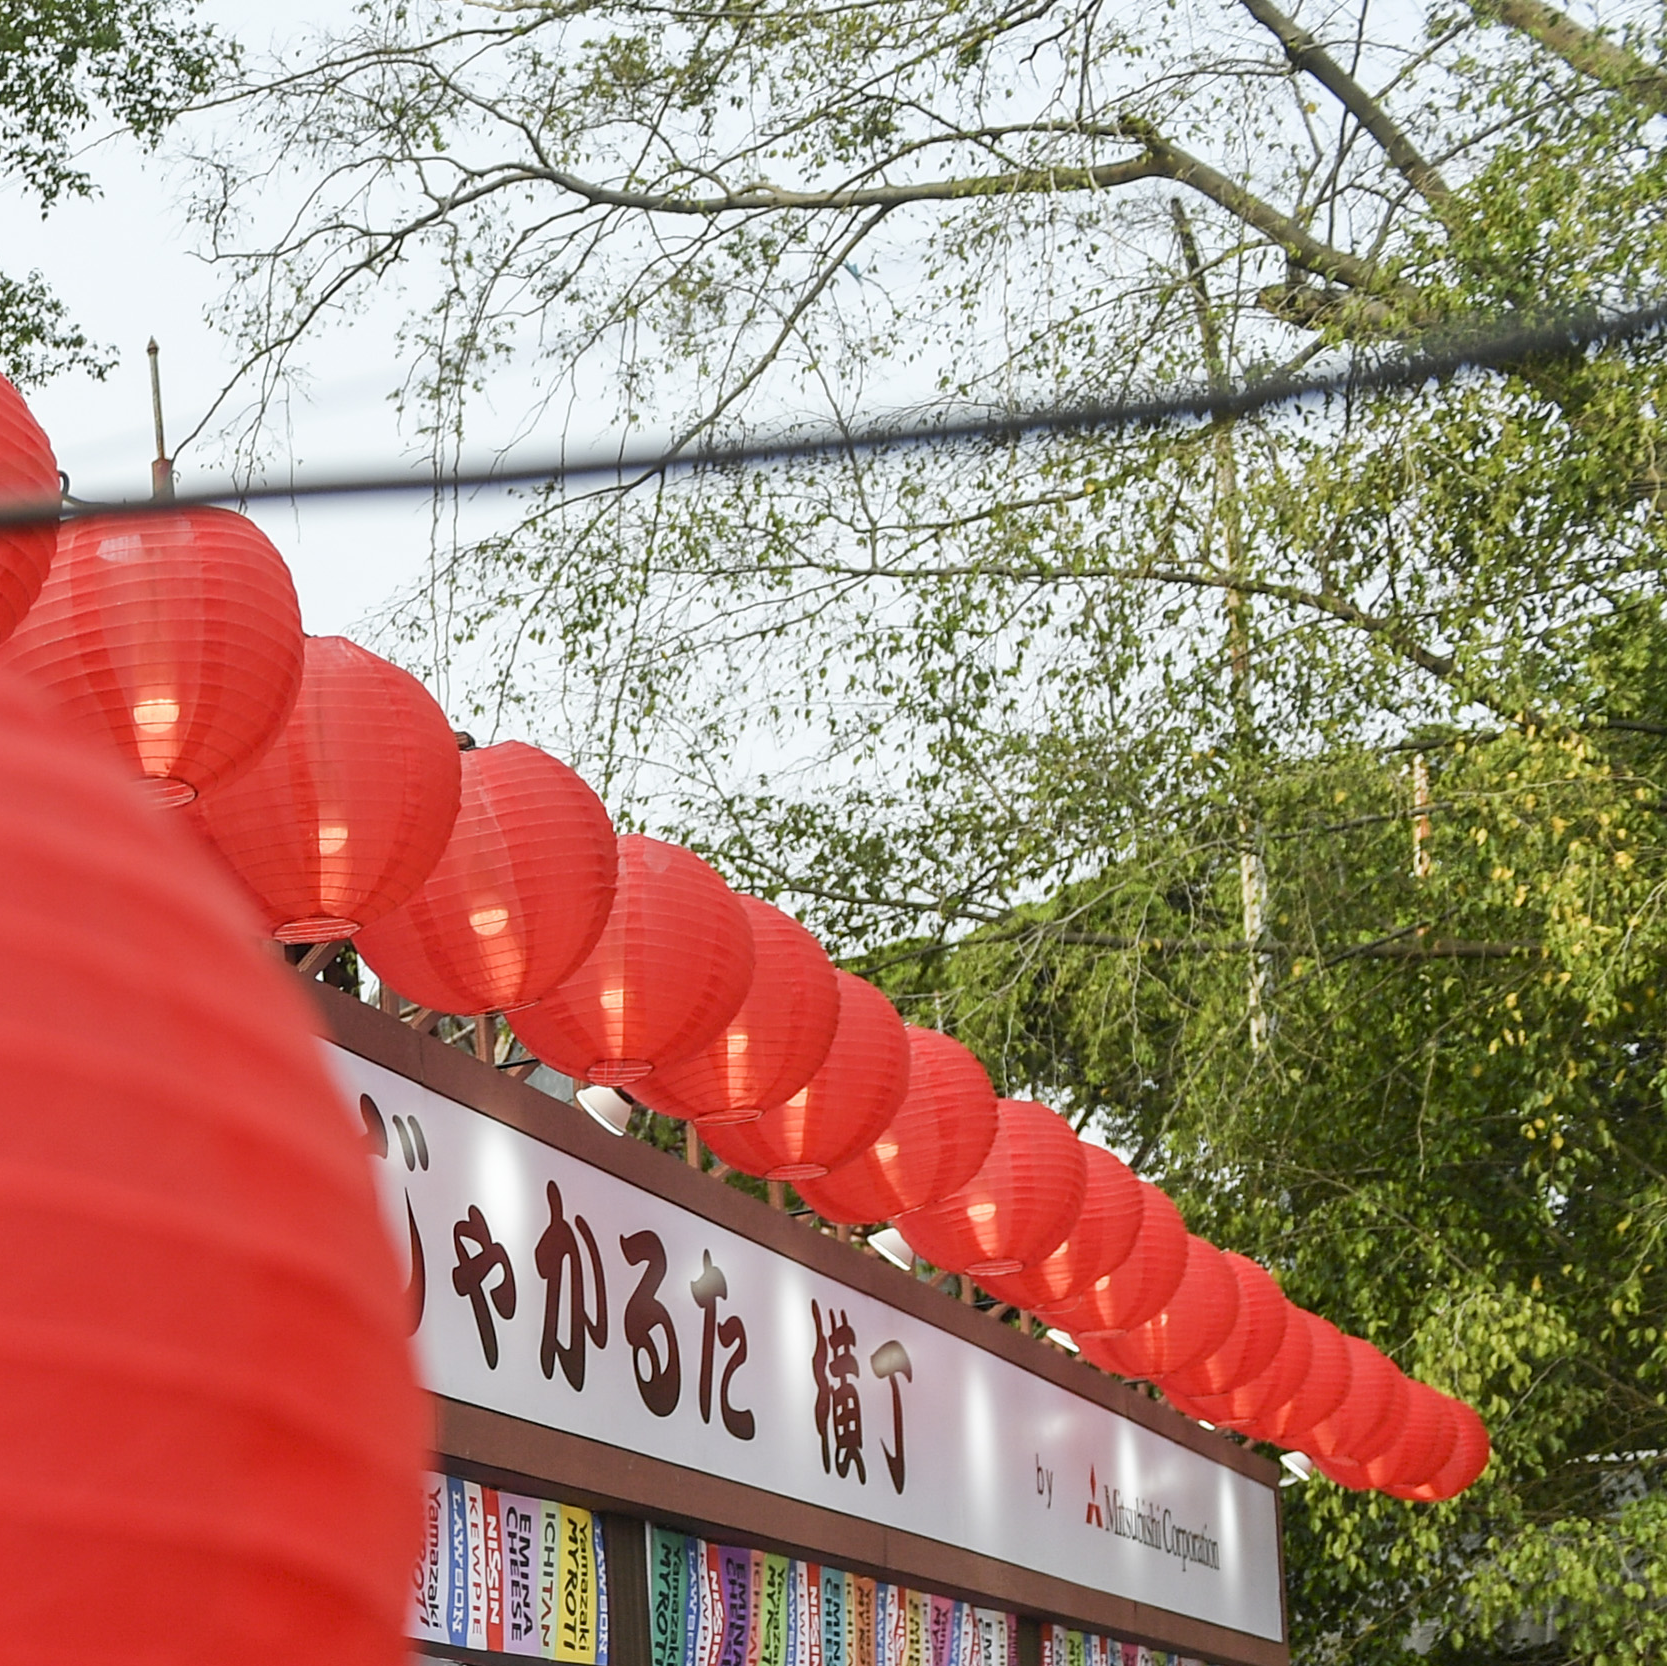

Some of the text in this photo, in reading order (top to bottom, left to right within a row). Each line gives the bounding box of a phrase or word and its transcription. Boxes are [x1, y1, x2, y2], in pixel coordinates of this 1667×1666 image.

[812, 1298, 913, 1495] 横丁
[427, 1486, 443, 1629] Yamazaki
[468, 1495, 483, 1635] KEWPIE
[486, 1514, 501, 1625] NISSIN
[505, 1505, 523, 1642] CHEESE
[518, 1513, 534, 1636] EMINA
[540, 1511, 557, 1648] ICHITAN
[1035, 1453, 1220, 1572] by Mitsubishi Corporation
[562, 1516, 579, 1652] MYROTI
[577, 1520, 591, 1652] Yamazaki
[710, 1570, 724, 1665] NISSIN
